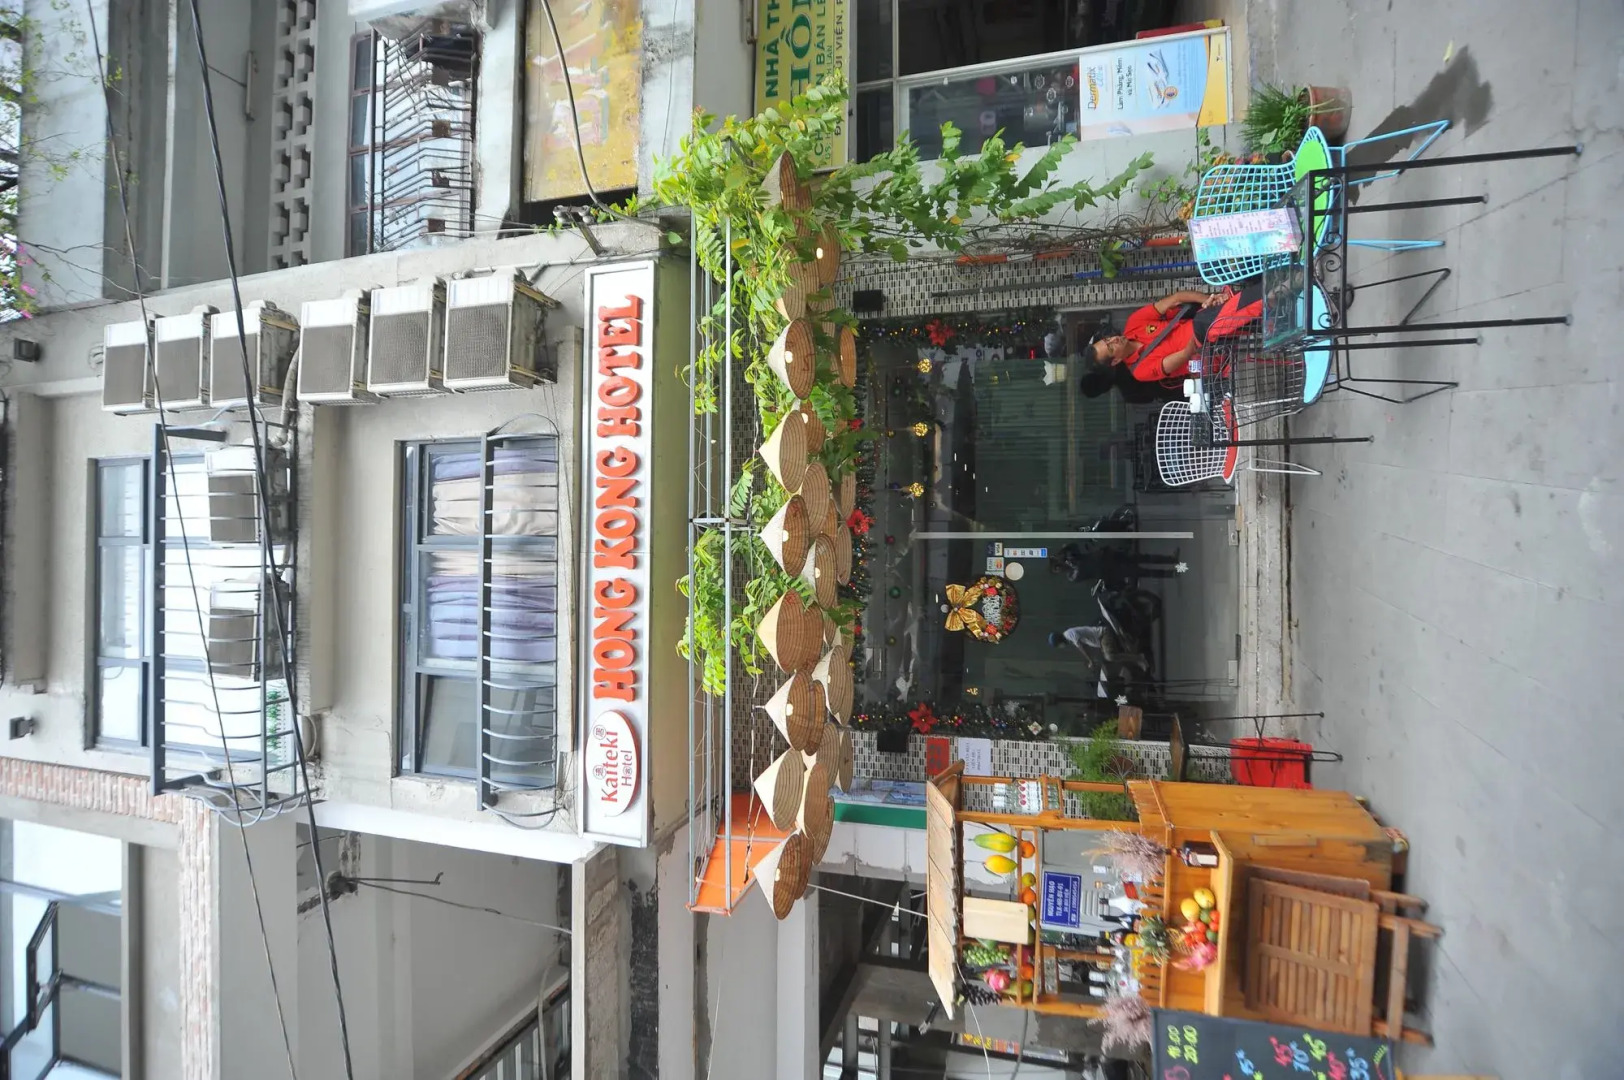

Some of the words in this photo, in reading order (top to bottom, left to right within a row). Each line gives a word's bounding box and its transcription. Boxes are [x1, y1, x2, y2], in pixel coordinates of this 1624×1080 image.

[763, 38, 779, 98] NHÀ
[813, 23, 826, 65] BÁN
[596, 294, 644, 438] HOTEL
[593, 446, 640, 570] KONG
[592, 578, 638, 703] HONG
[599, 730, 618, 802] Kaiteki
